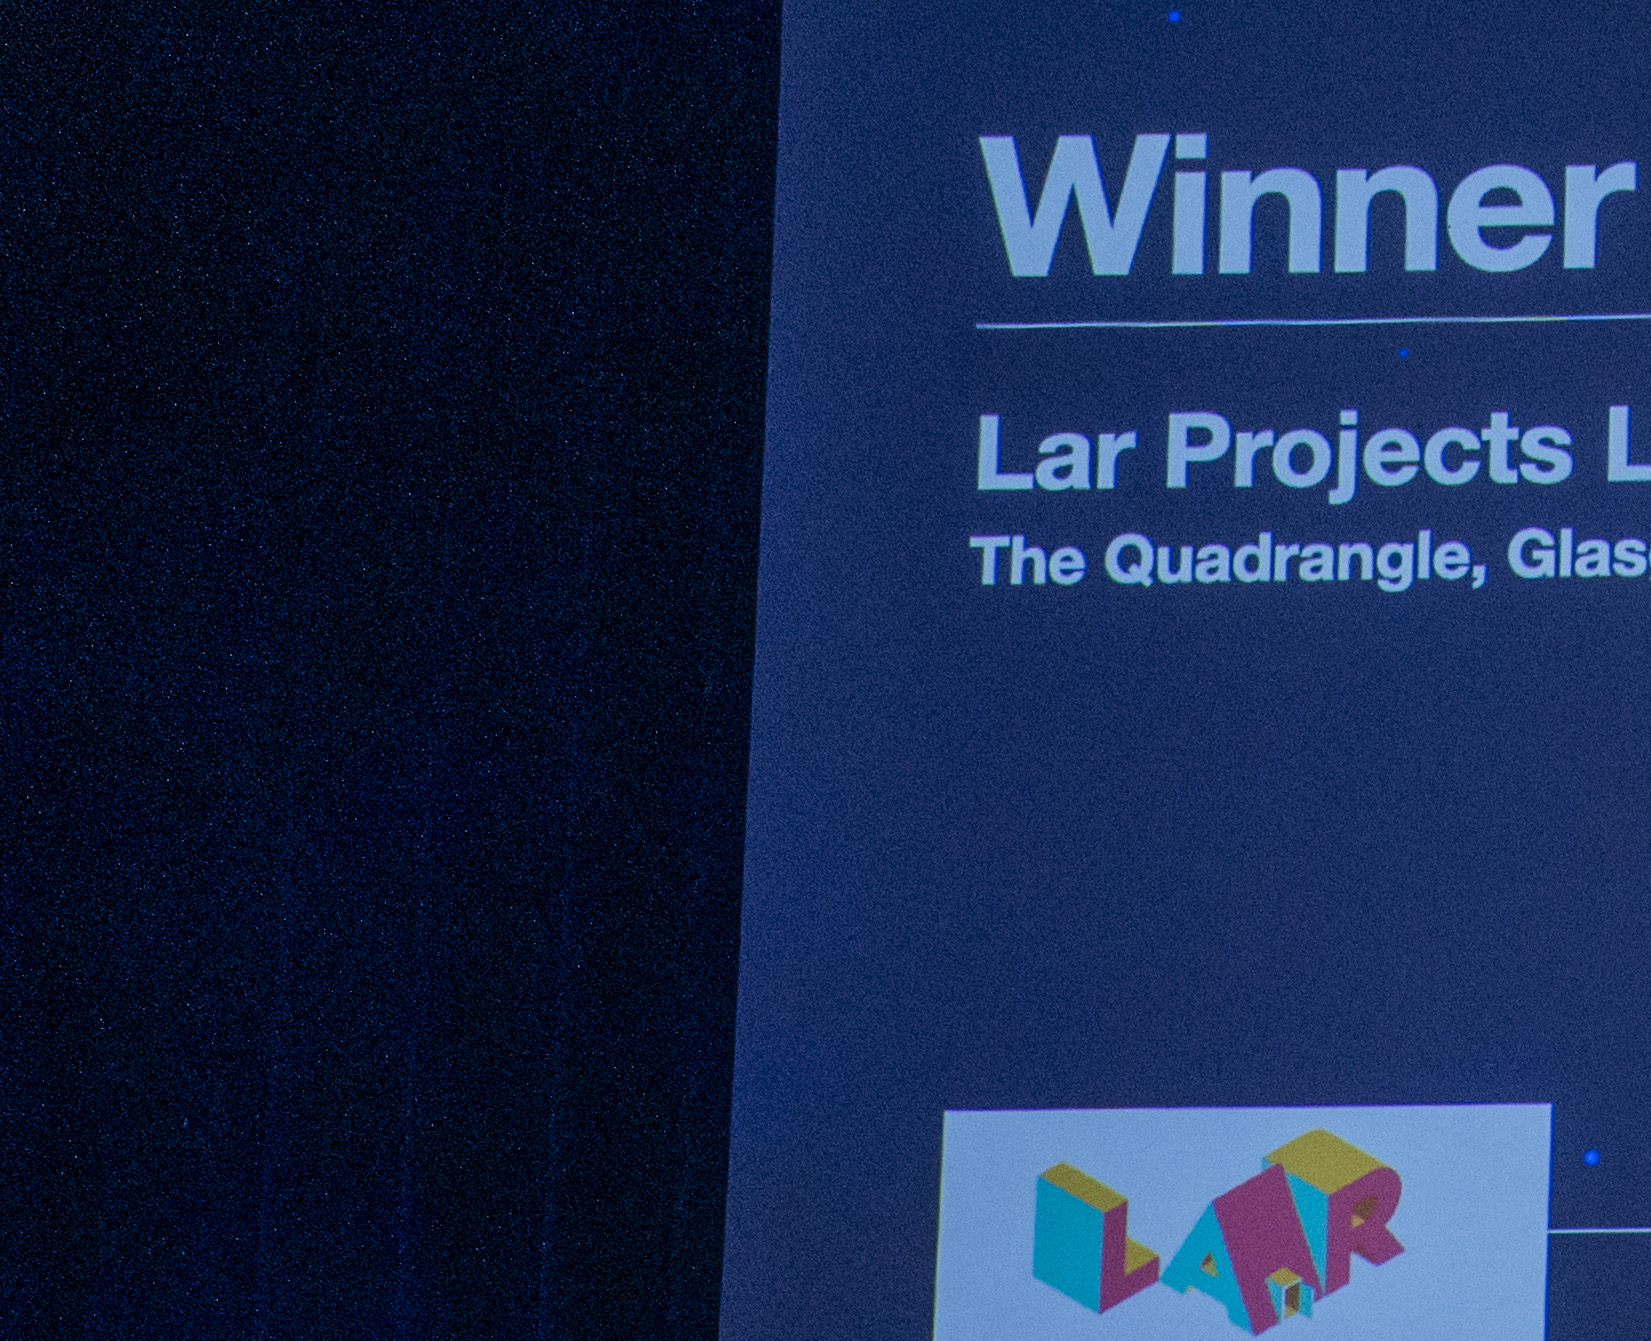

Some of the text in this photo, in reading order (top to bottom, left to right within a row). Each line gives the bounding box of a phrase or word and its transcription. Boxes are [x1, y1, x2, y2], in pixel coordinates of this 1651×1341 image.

[979, 132, 1638, 277] Winner
[976, 414, 1137, 490] Lar
[1165, 409, 1573, 504] Projects
[970, 535, 1086, 585] The
[1104, 529, 1486, 592] Quadrangle,
